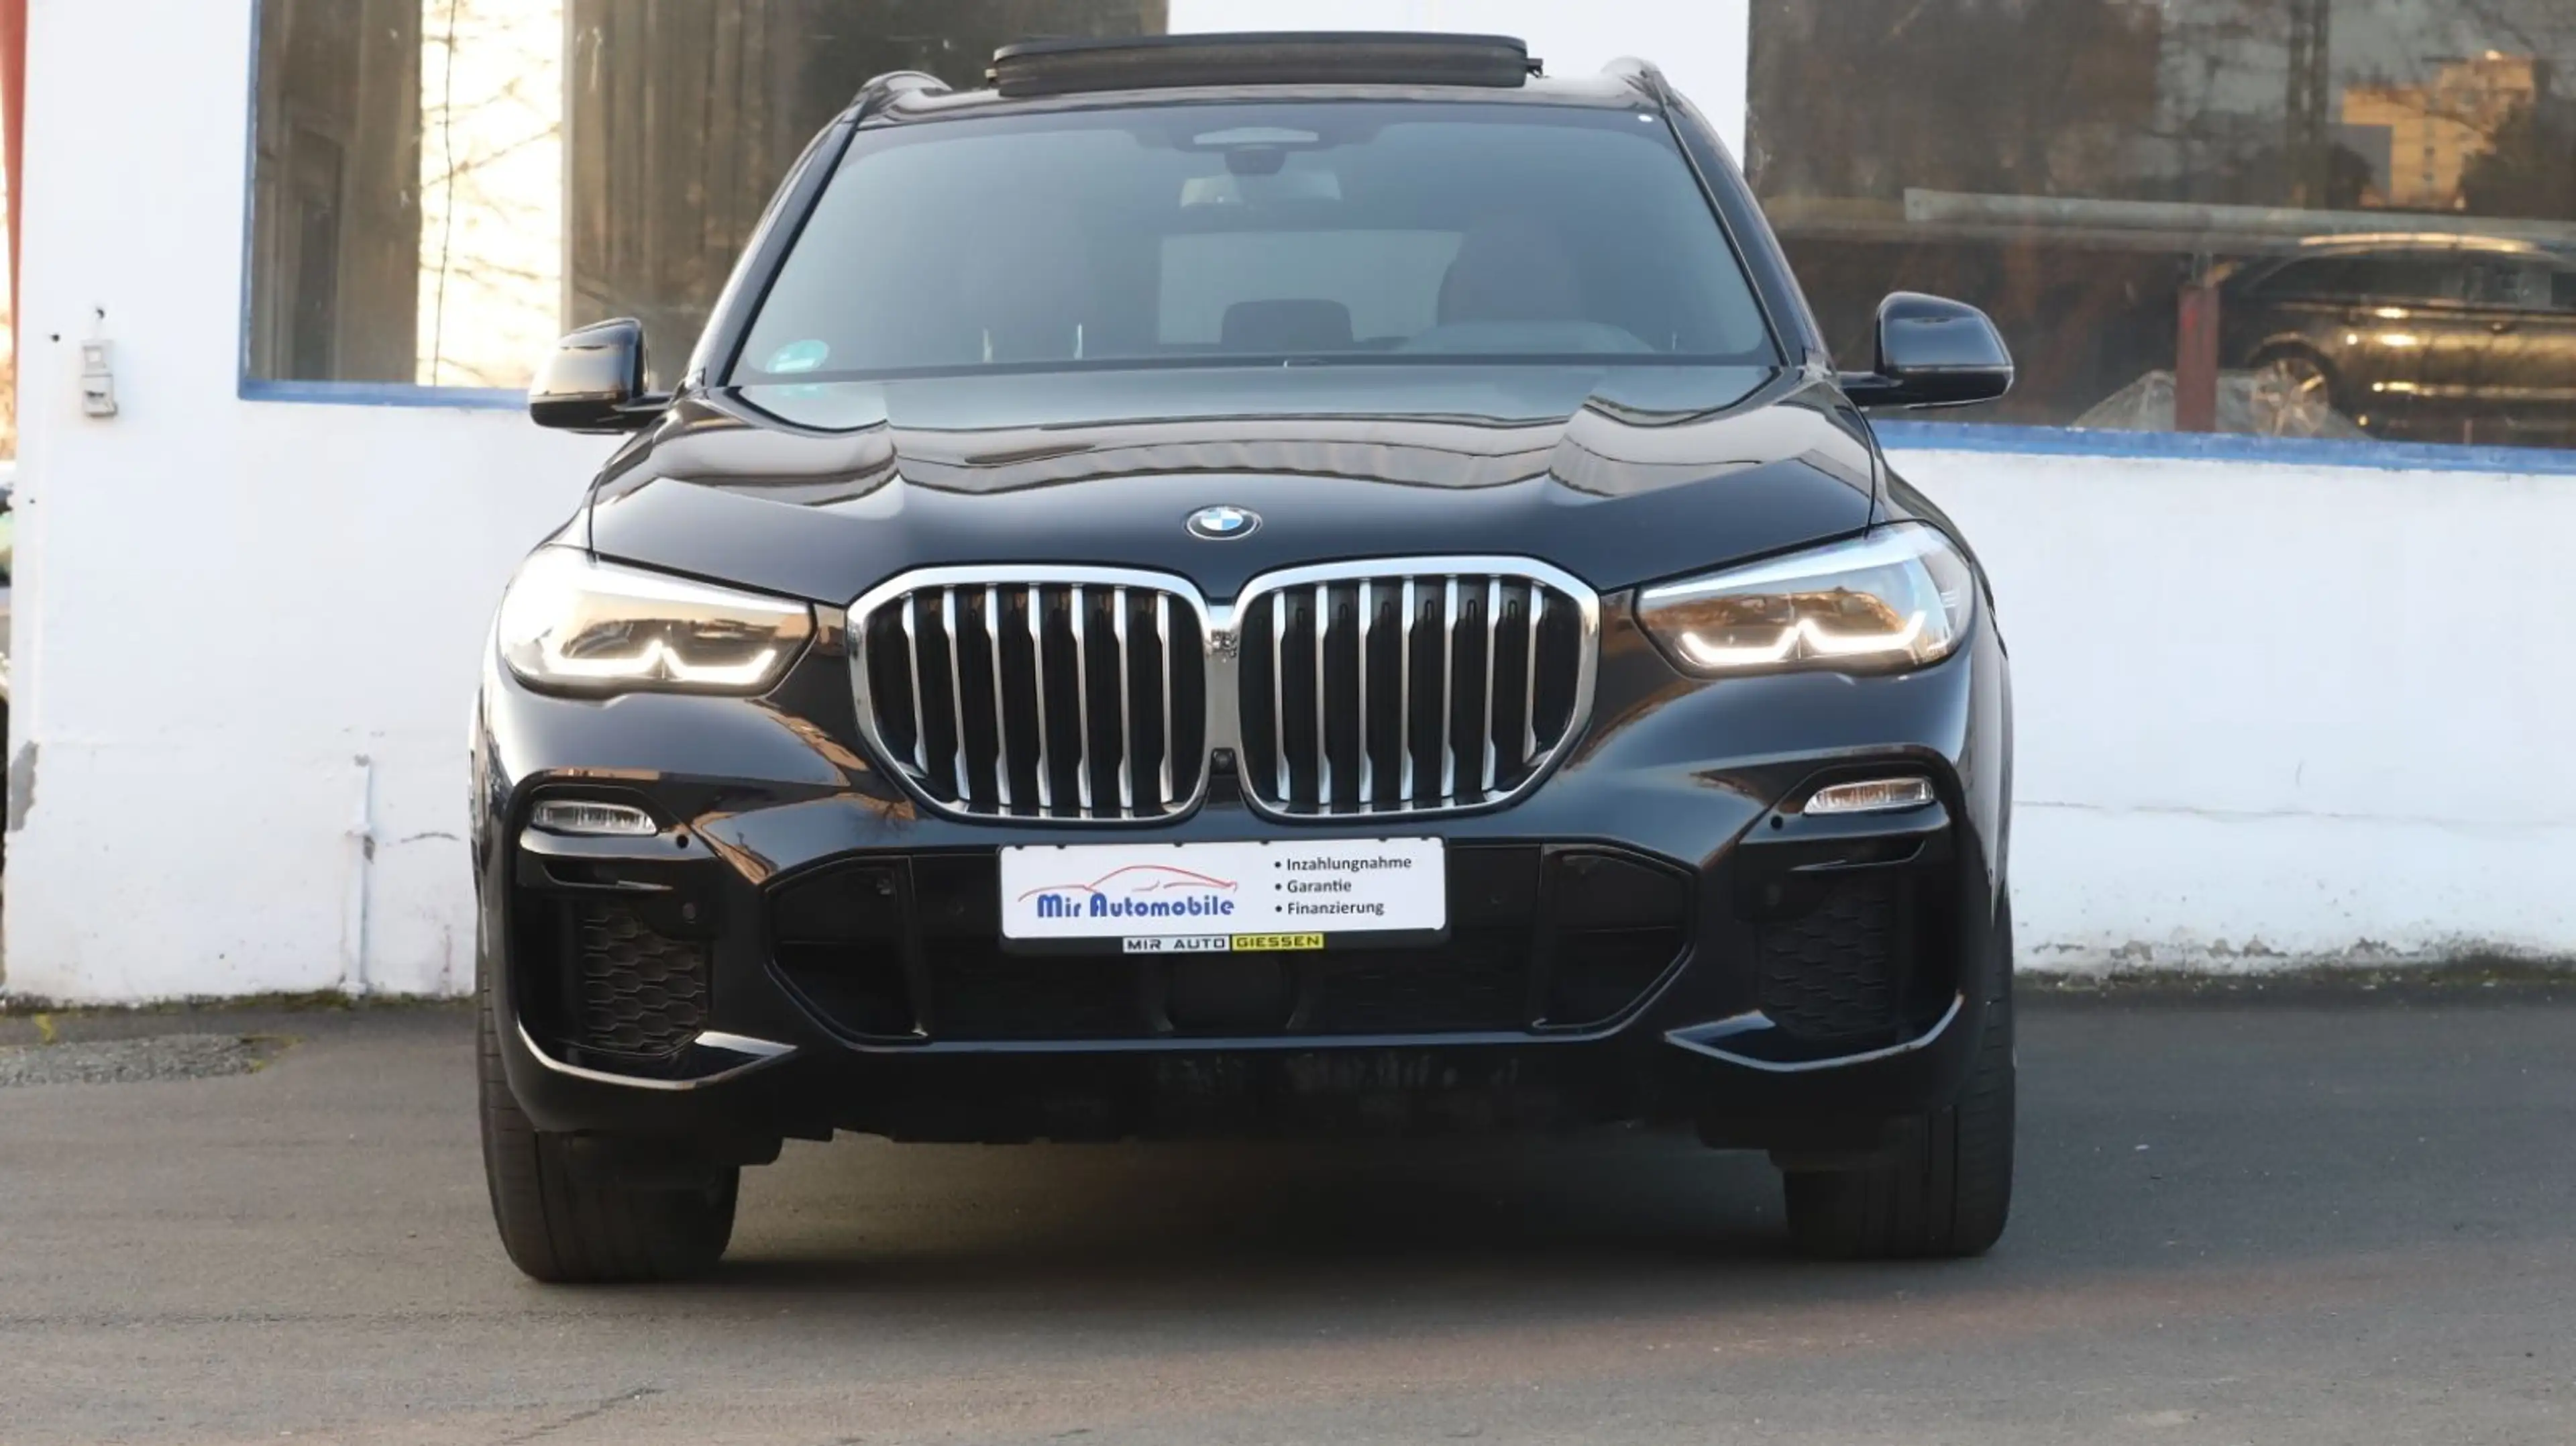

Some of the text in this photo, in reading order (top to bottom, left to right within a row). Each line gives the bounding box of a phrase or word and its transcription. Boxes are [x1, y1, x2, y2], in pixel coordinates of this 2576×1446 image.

[1287, 856, 1412, 872] Inzahlungnahme
[1287, 878, 1352, 893] Garantie
[1036, 892, 1235, 918] Mir Automobile
[1287, 901, 1385, 916] Finanzierung
[1127, 935, 1321, 951] MIR AUTO GIESSEN
